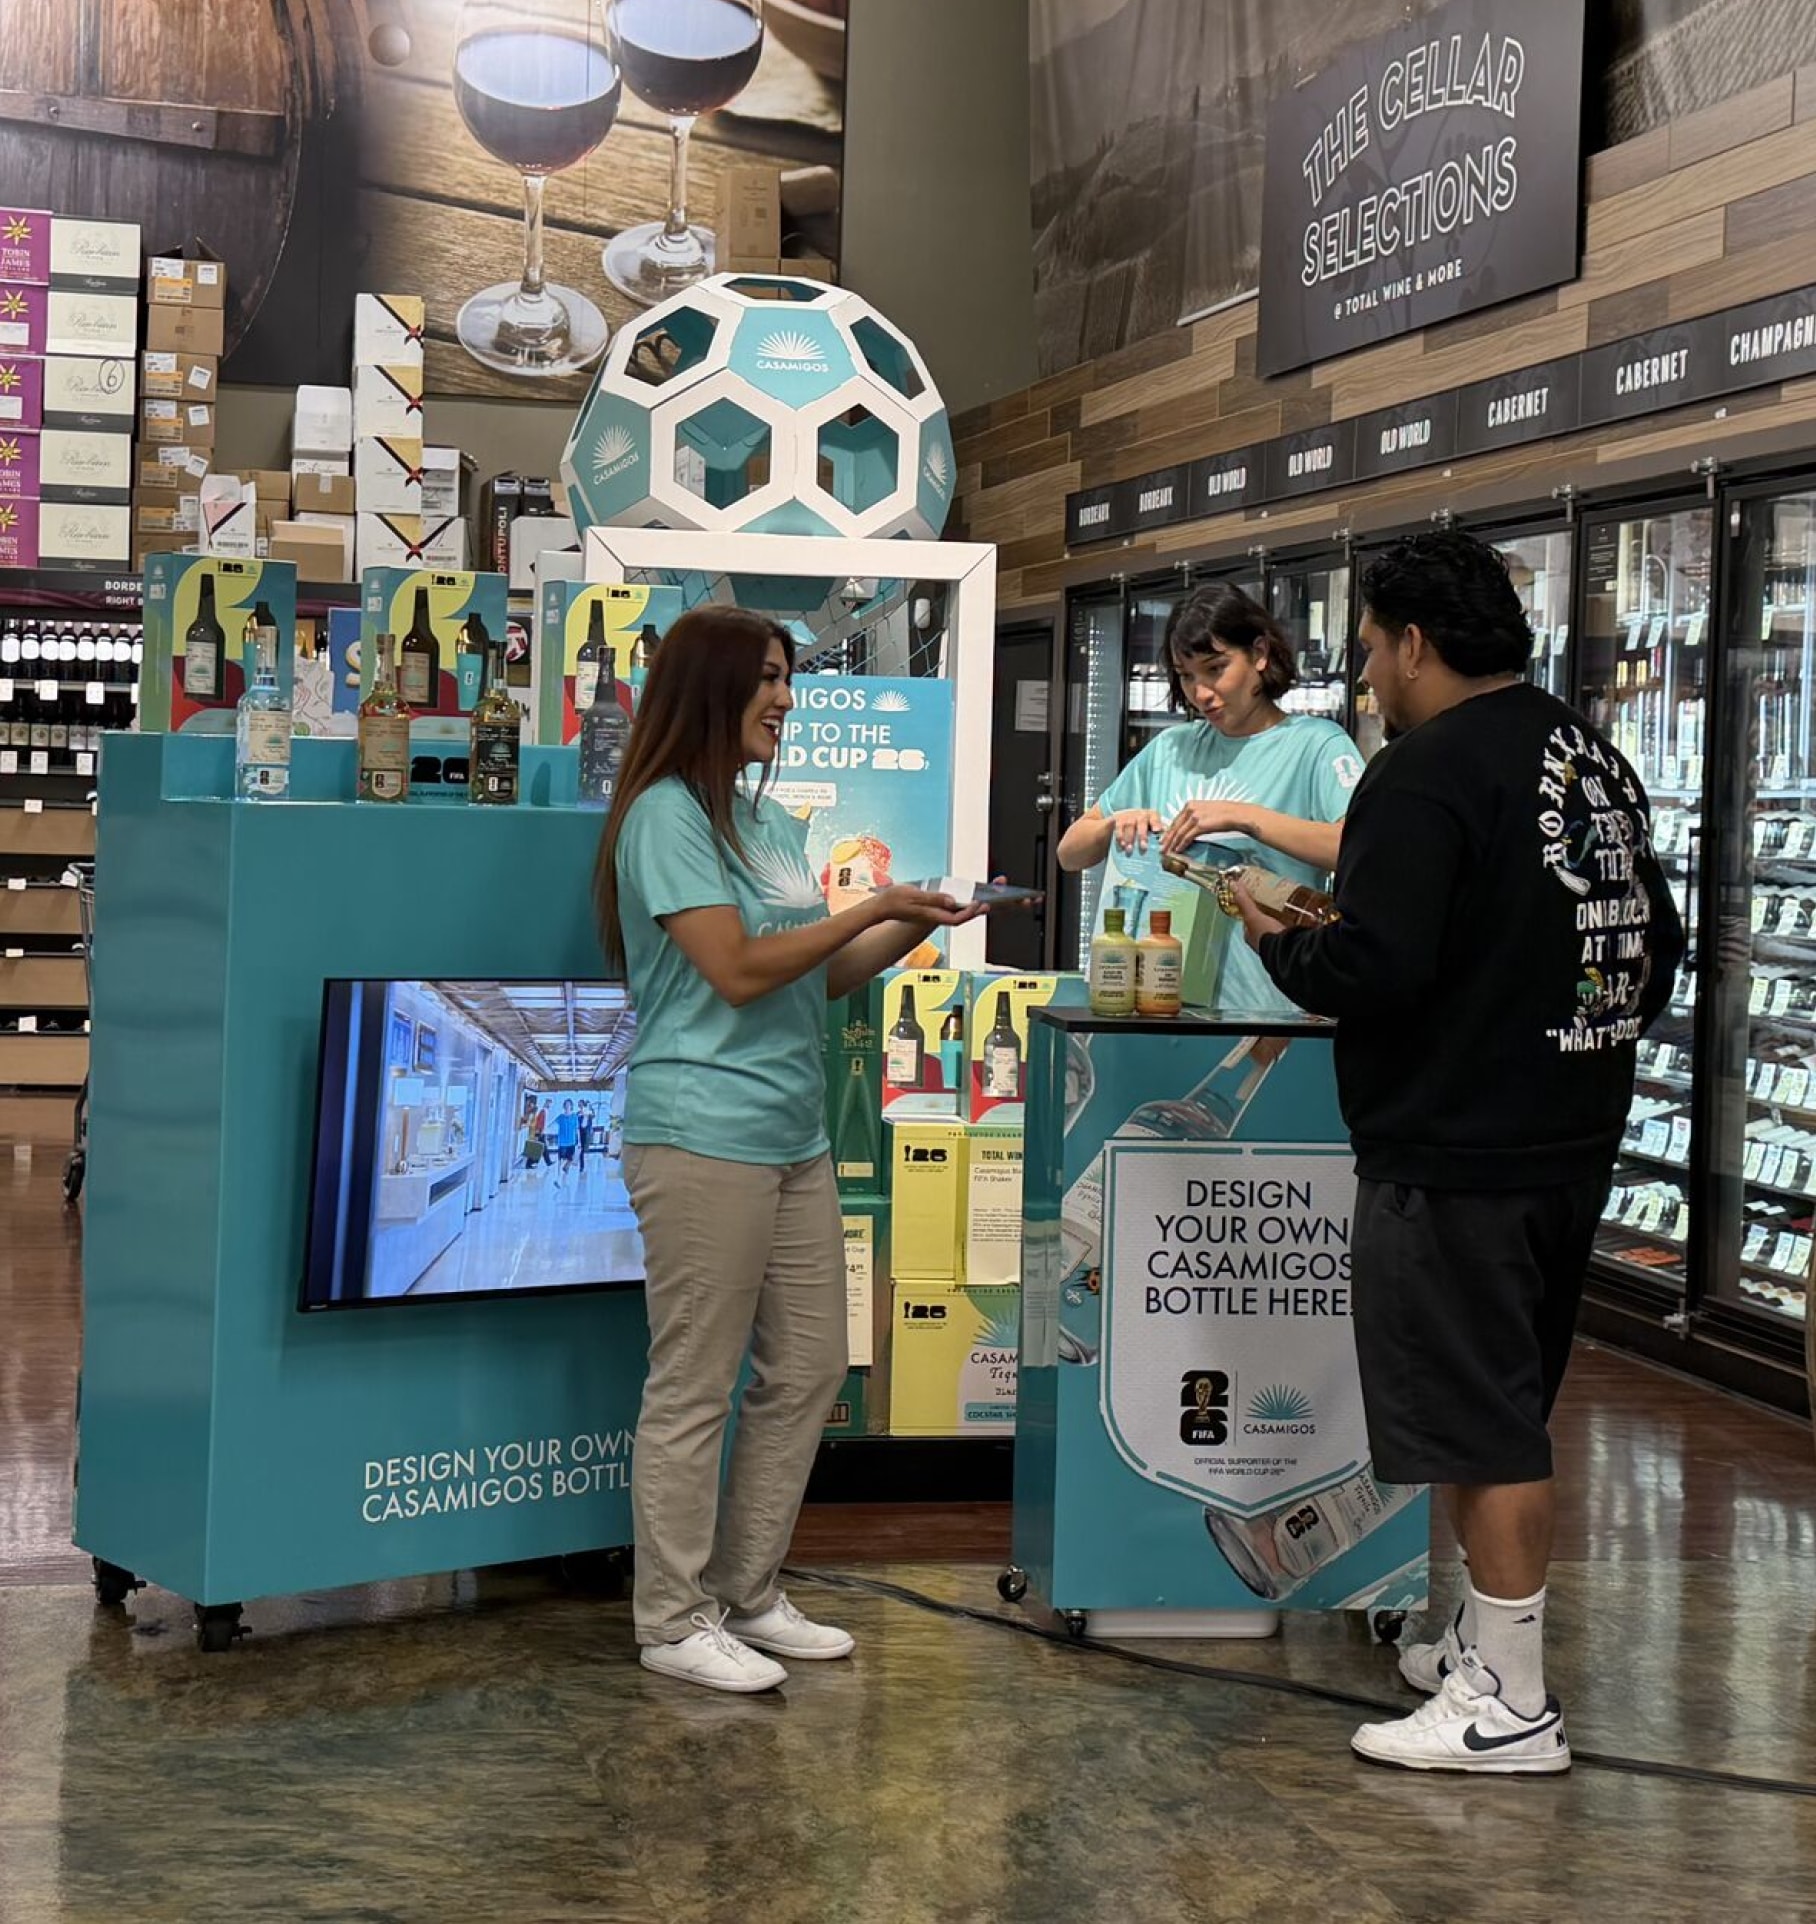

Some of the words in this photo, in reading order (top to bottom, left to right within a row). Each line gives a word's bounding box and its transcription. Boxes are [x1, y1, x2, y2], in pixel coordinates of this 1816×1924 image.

[1303, 84, 1369, 207] THE
[1378, 31, 1525, 131] CELLAR
[1301, 136, 1517, 287] SELECTIONS
[1345, 292, 1379, 316] TOTAL
[1382, 279, 1412, 303] WINE
[1415, 275, 1423, 292] &
[1427, 258, 1463, 288] MORE
[1729, 313, 1816, 366] CHAMPAGN
[106, 360, 119, 388] 6
[756, 359, 829, 374] CASAMIGOS
[1616, 349, 1689, 395] CABERNET
[1487, 387, 1549, 428] CABERNET
[1380, 429, 1397, 455] OLD
[1398, 418, 1431, 450] WORLD
[0, 470, 21, 478] OBIN
[592, 451, 640, 486] CASAMIGOS
[1288, 452, 1303, 477] OLD
[1304, 444, 1333, 474] WORLD
[104, 580, 143, 592] BORDE
[105, 597, 135, 606] RIGHT
[782, 722, 803, 743] IP
[810, 723, 842, 743] TO
[848, 724, 891, 744] THE
[773, 746, 807, 768] LD
[811, 747, 868, 770] CUP
[1580, 935, 1606, 963] AT
[981, 1150, 1004, 1160] TOTAL
[1006, 1150, 1022, 1160] WIN
[1186, 1179, 1311, 1210] DESIGN
[1155, 1214, 1248, 1244] YOUR
[1258, 1216, 1348, 1246] OWN
[1147, 1250, 1351, 1281] CASAMIGOS
[1145, 1286, 1257, 1316] BOTTLE
[970, 1352, 1018, 1364] CASAM
[1192, 1429, 1215, 1440] FIFA
[1243, 1423, 1316, 1435] CASAMIGOS
[364, 1448, 475, 1490] DESIGN
[484, 1438, 562, 1473] YOUR
[570, 1429, 636, 1462] OWN
[362, 1472, 543, 1524] CASAMIGOS
[552, 1462, 631, 1498] BOTTL
